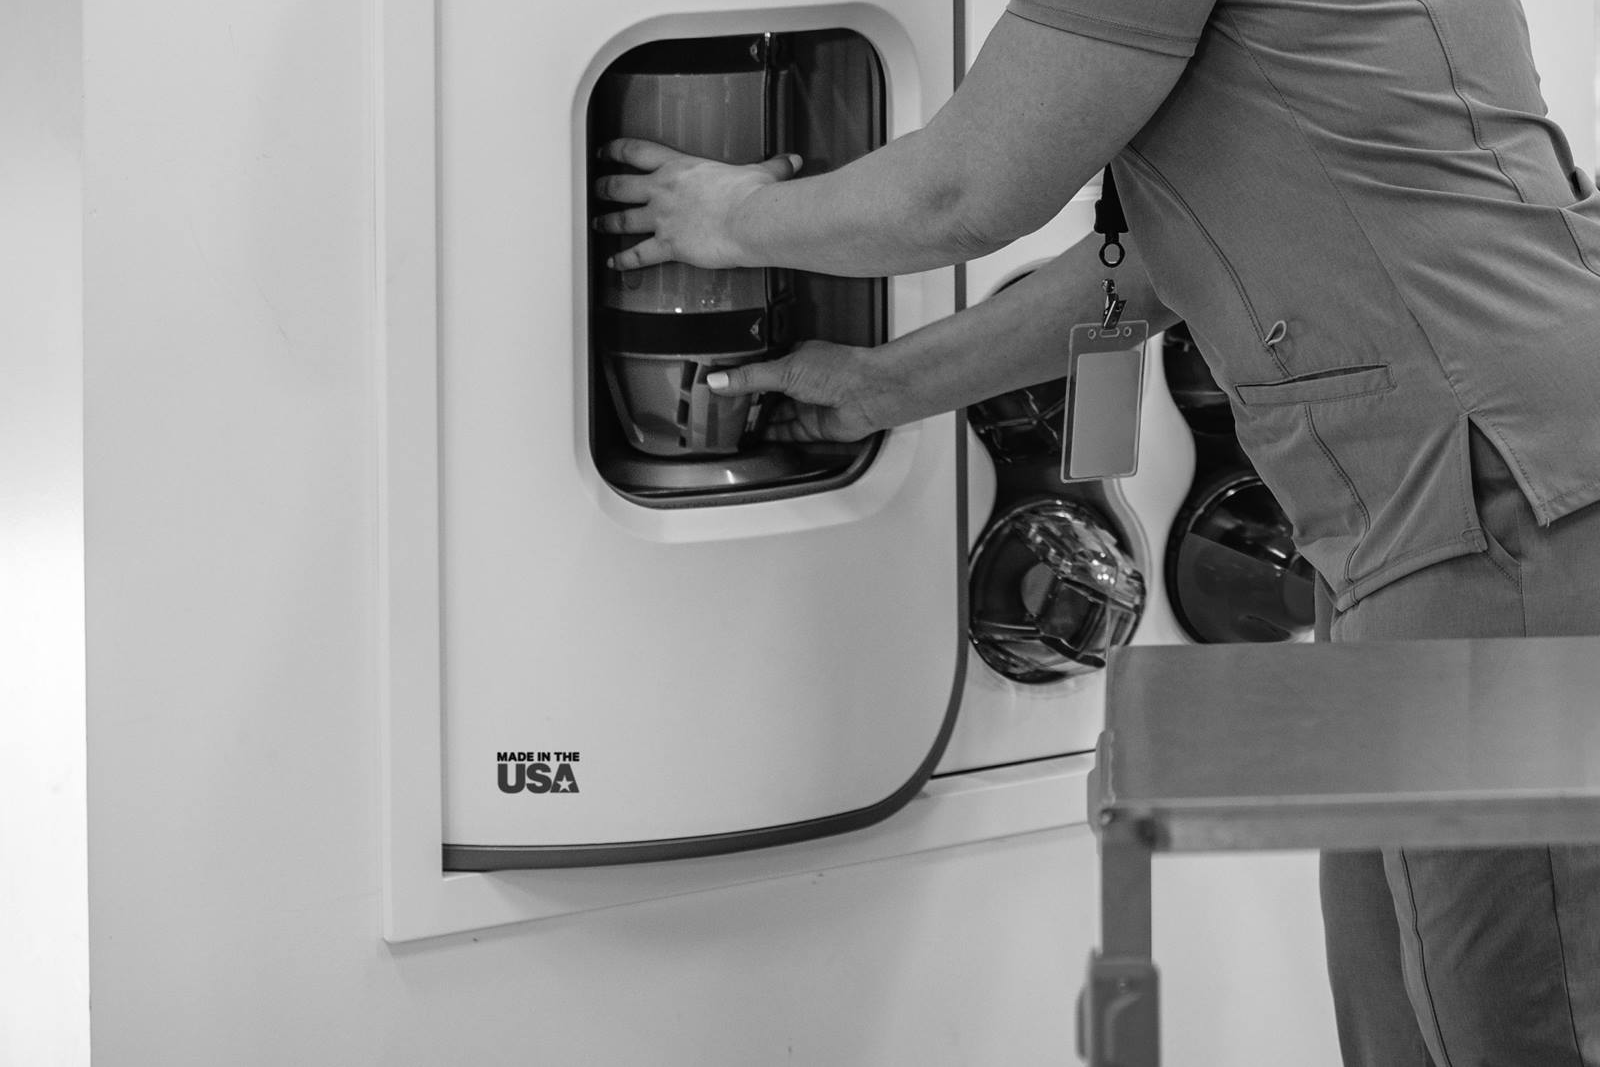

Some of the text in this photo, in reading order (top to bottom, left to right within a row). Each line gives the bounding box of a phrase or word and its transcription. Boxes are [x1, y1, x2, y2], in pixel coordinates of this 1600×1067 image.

[496, 751, 580, 762] MADE IN THE
[497, 762, 580, 795] USA
